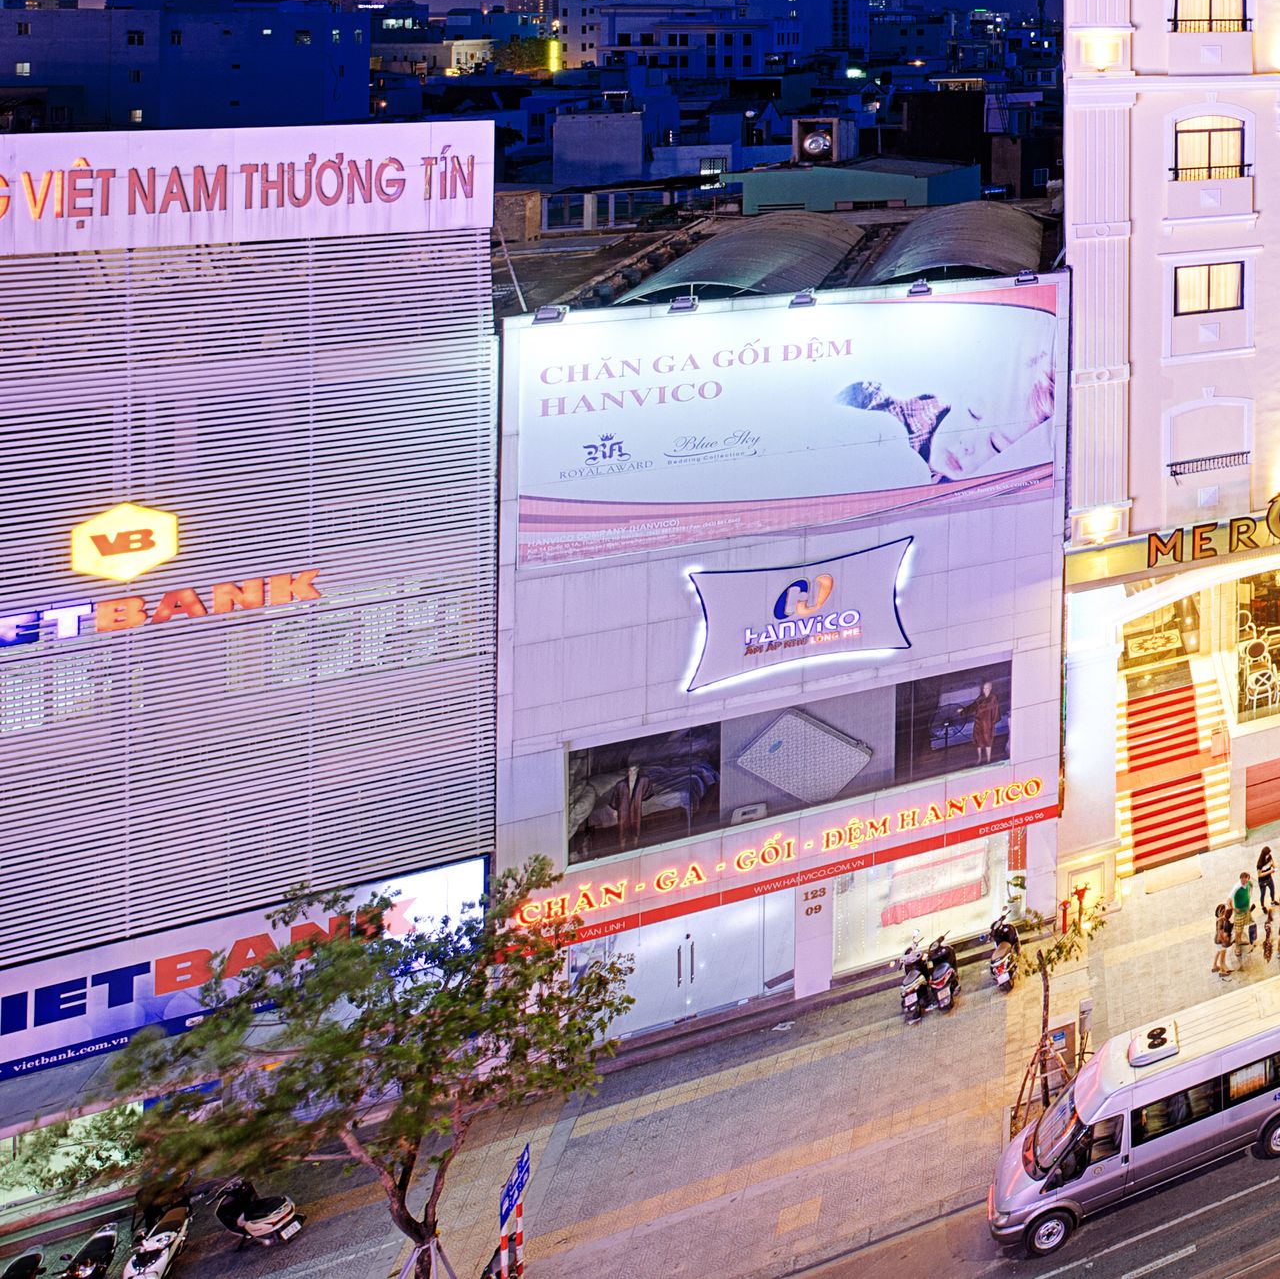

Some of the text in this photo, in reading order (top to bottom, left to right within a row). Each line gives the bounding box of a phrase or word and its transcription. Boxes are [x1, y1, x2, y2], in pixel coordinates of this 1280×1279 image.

[20, 157, 117, 229] VIỆT
[127, 165, 229, 217] NAM
[240, 152, 407, 211] THƯƠNG
[420, 145, 475, 201] TÍN
[539, 336, 855, 388] CHĂN GA GỐI ĐỆM
[539, 379, 725, 419] HANVICO
[672, 429, 761, 453] Blue Sky
[559, 459, 654, 480] ROYAL AWARD
[667, 451, 746, 466] Bedding Collection
[89, 528, 157, 558] VB
[514, 775, 1045, 928] CHĂN GA GỐI ĐỆM HANVICO
[753, 858, 865, 895] WWW.HANVICO.COM.VN
[802, 886, 827, 903] 123
[804, 904, 823, 918] 09
[603, 920, 627, 935] LINH
[13, 1034, 130, 1073] vietbank.com.vn
